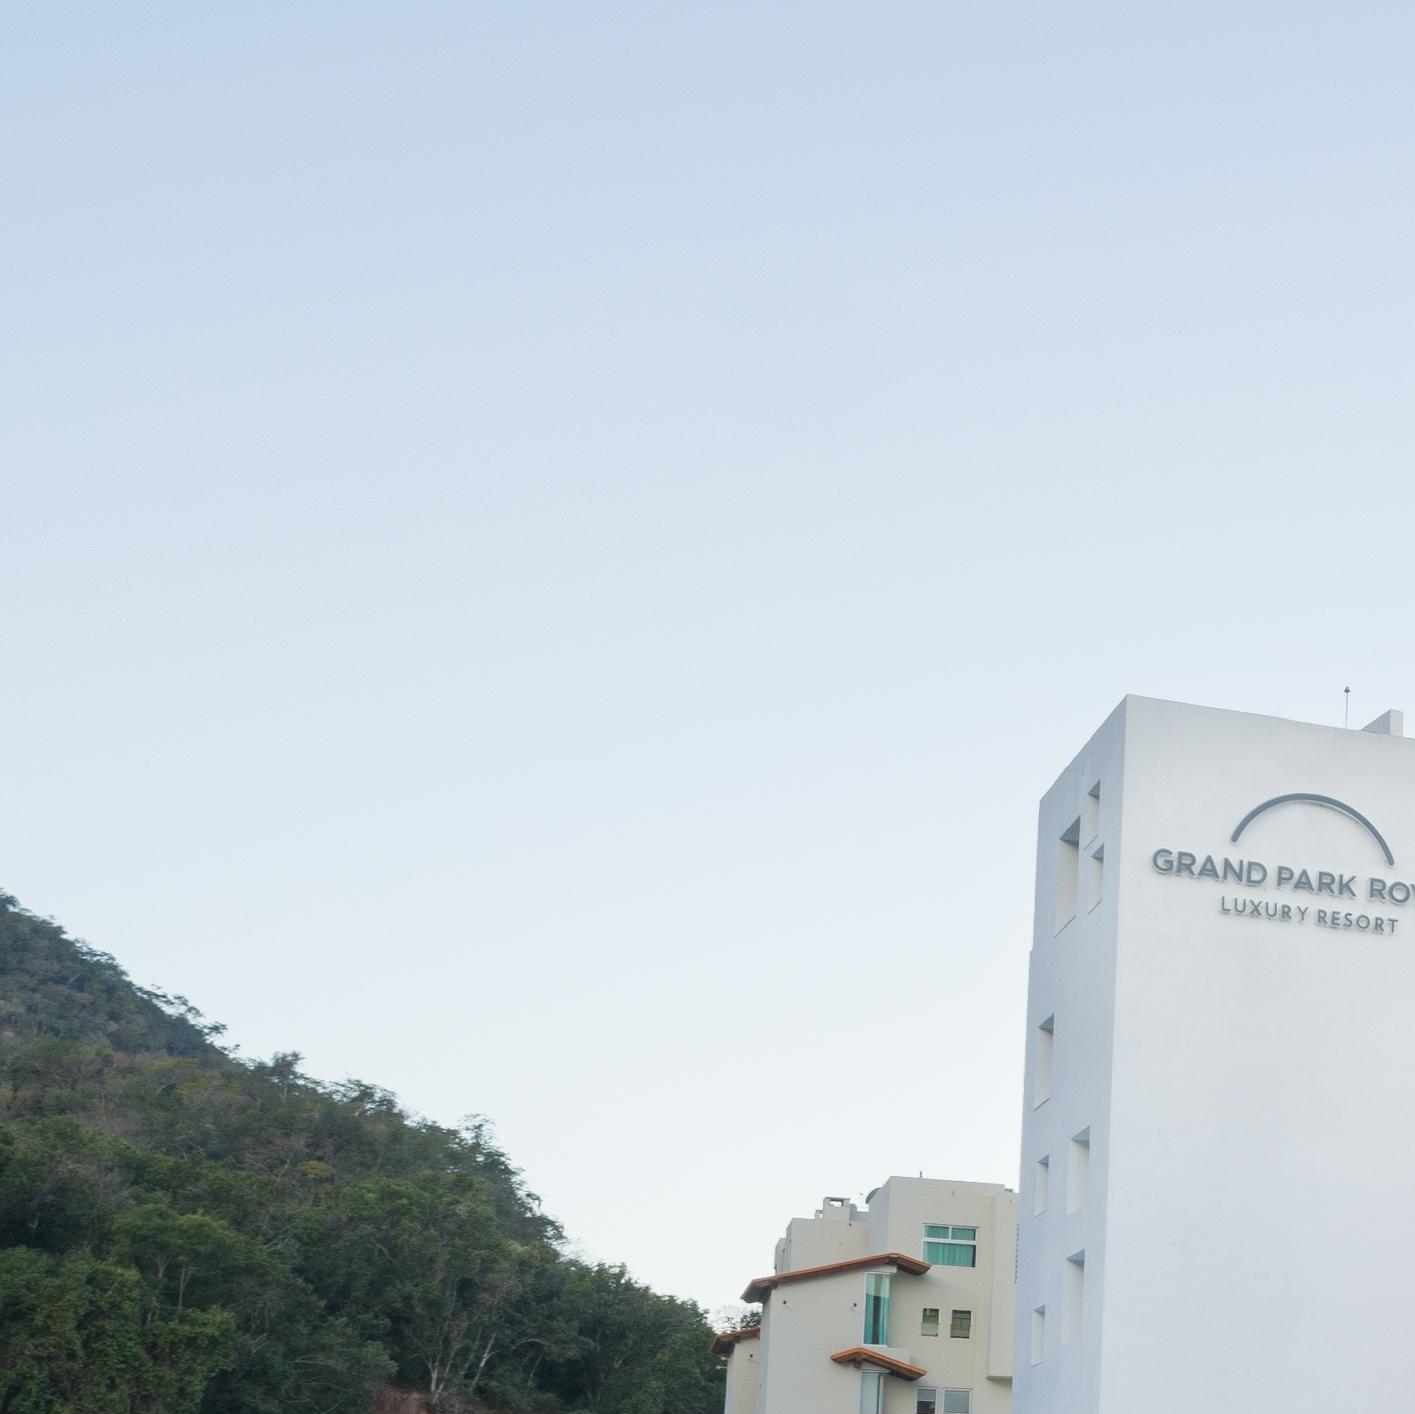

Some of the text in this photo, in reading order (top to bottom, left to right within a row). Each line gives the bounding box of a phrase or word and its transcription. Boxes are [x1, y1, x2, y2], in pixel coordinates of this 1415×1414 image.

[1151, 847, 1268, 887] GRAND
[1276, 865, 1357, 898] PARK
[1221, 895, 1400, 935] LUXURY RESORT
